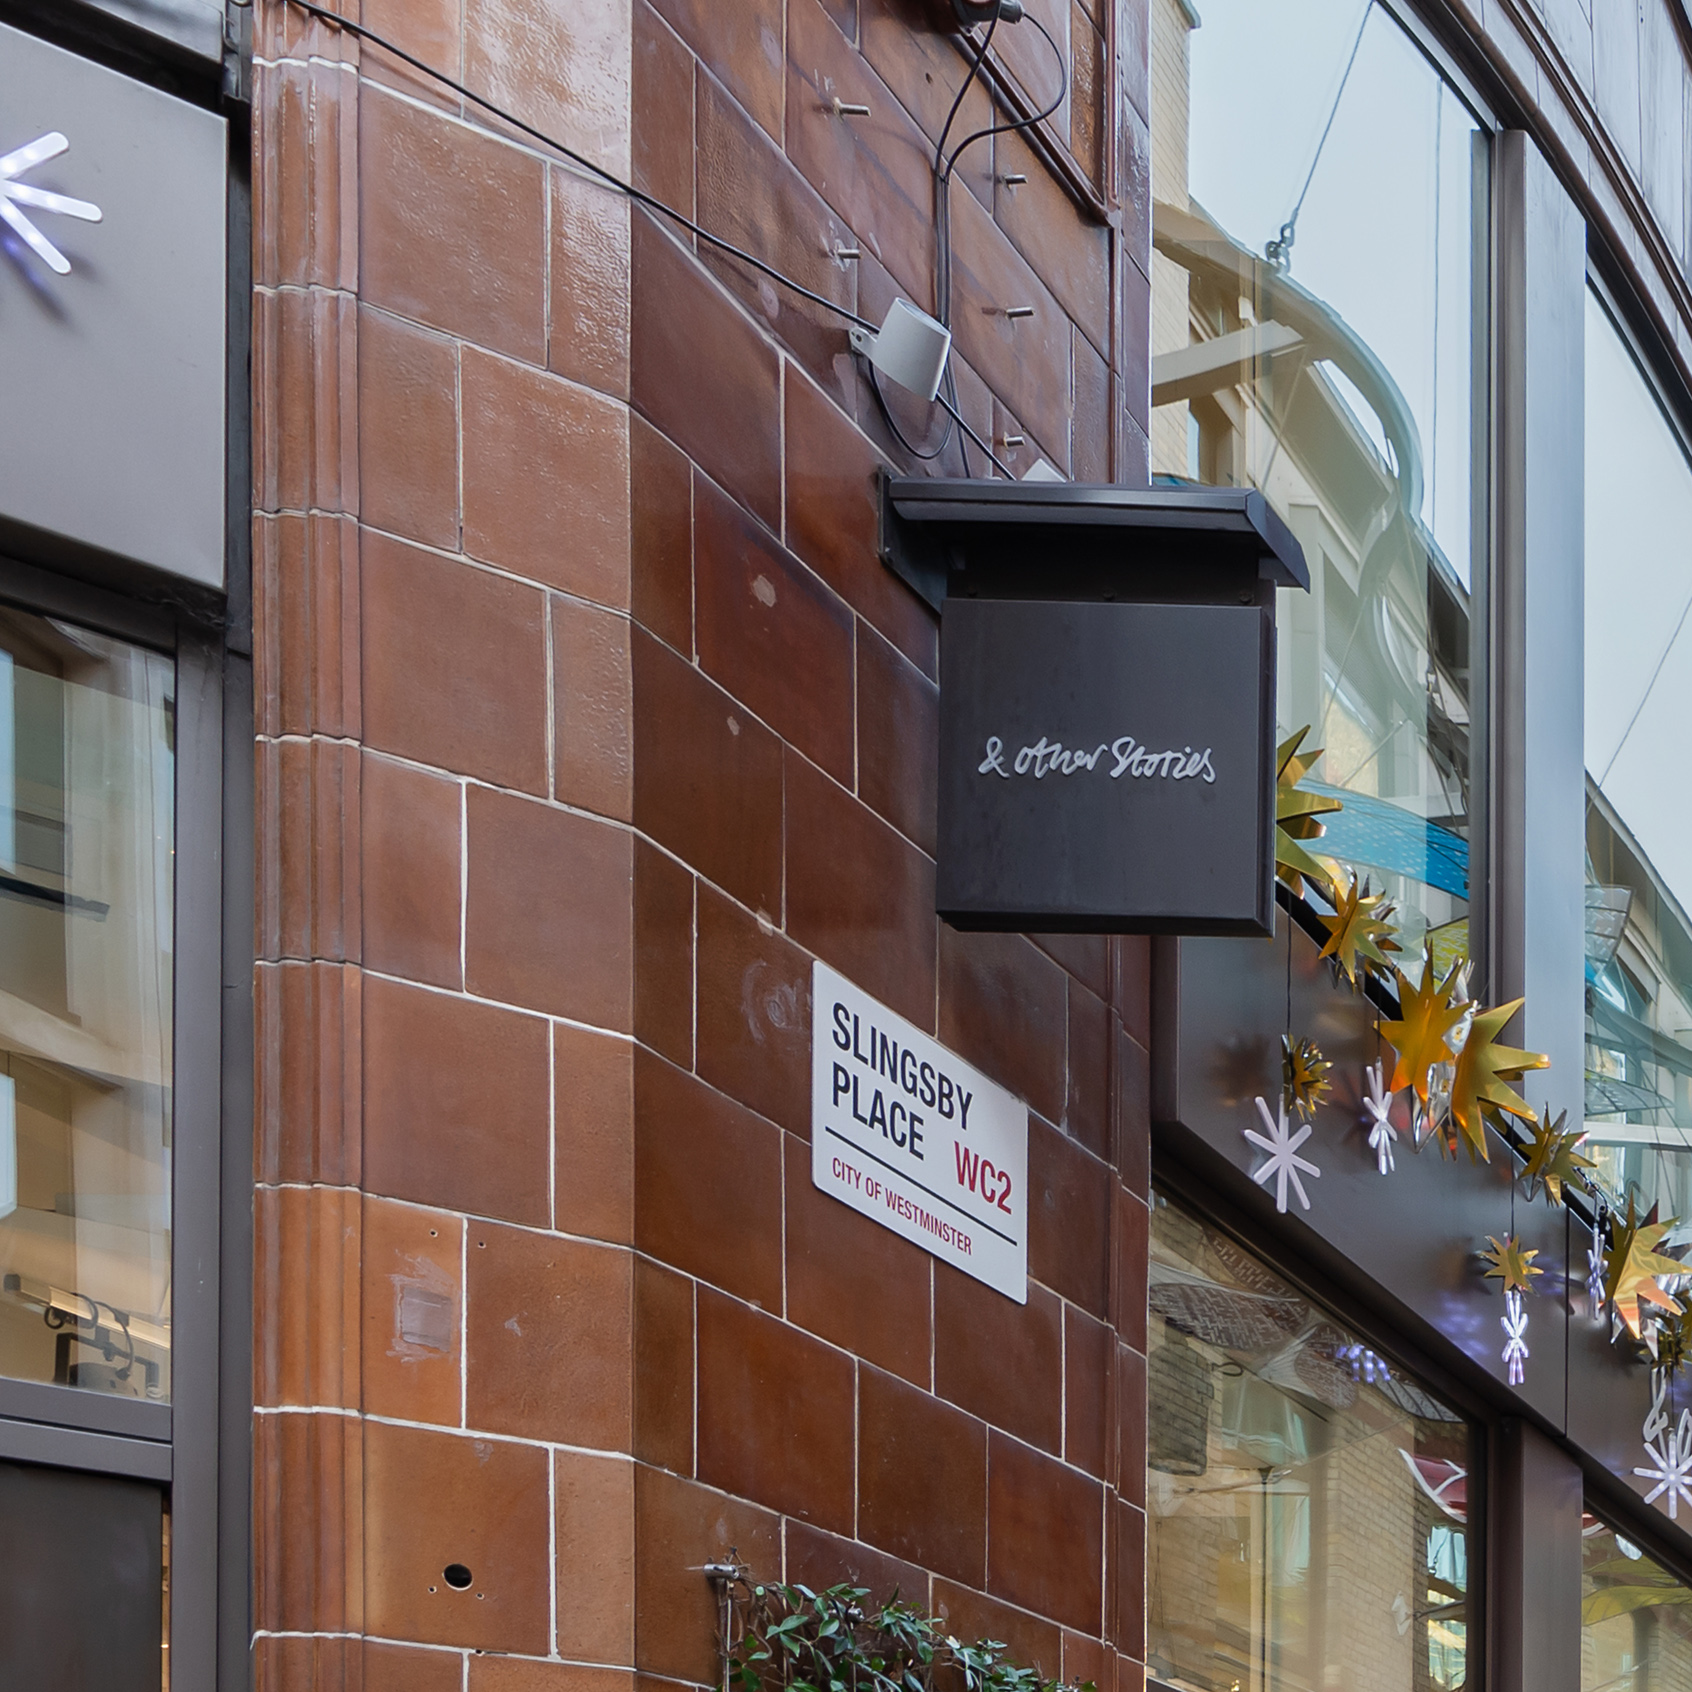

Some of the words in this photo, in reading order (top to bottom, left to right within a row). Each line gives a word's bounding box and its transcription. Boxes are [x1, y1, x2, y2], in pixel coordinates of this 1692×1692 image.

[978, 736, 1011, 779] &
[1014, 736, 1109, 779] other
[1109, 736, 1216, 784] Stories
[832, 1001, 973, 1131] SLINGSBY
[832, 1060, 924, 1161] PLACE
[832, 1157, 862, 1190] CITY
[866, 1177, 882, 1200] OF
[885, 1187, 972, 1255] WESTMINSTER
[954, 1140, 1012, 1215] WC2
